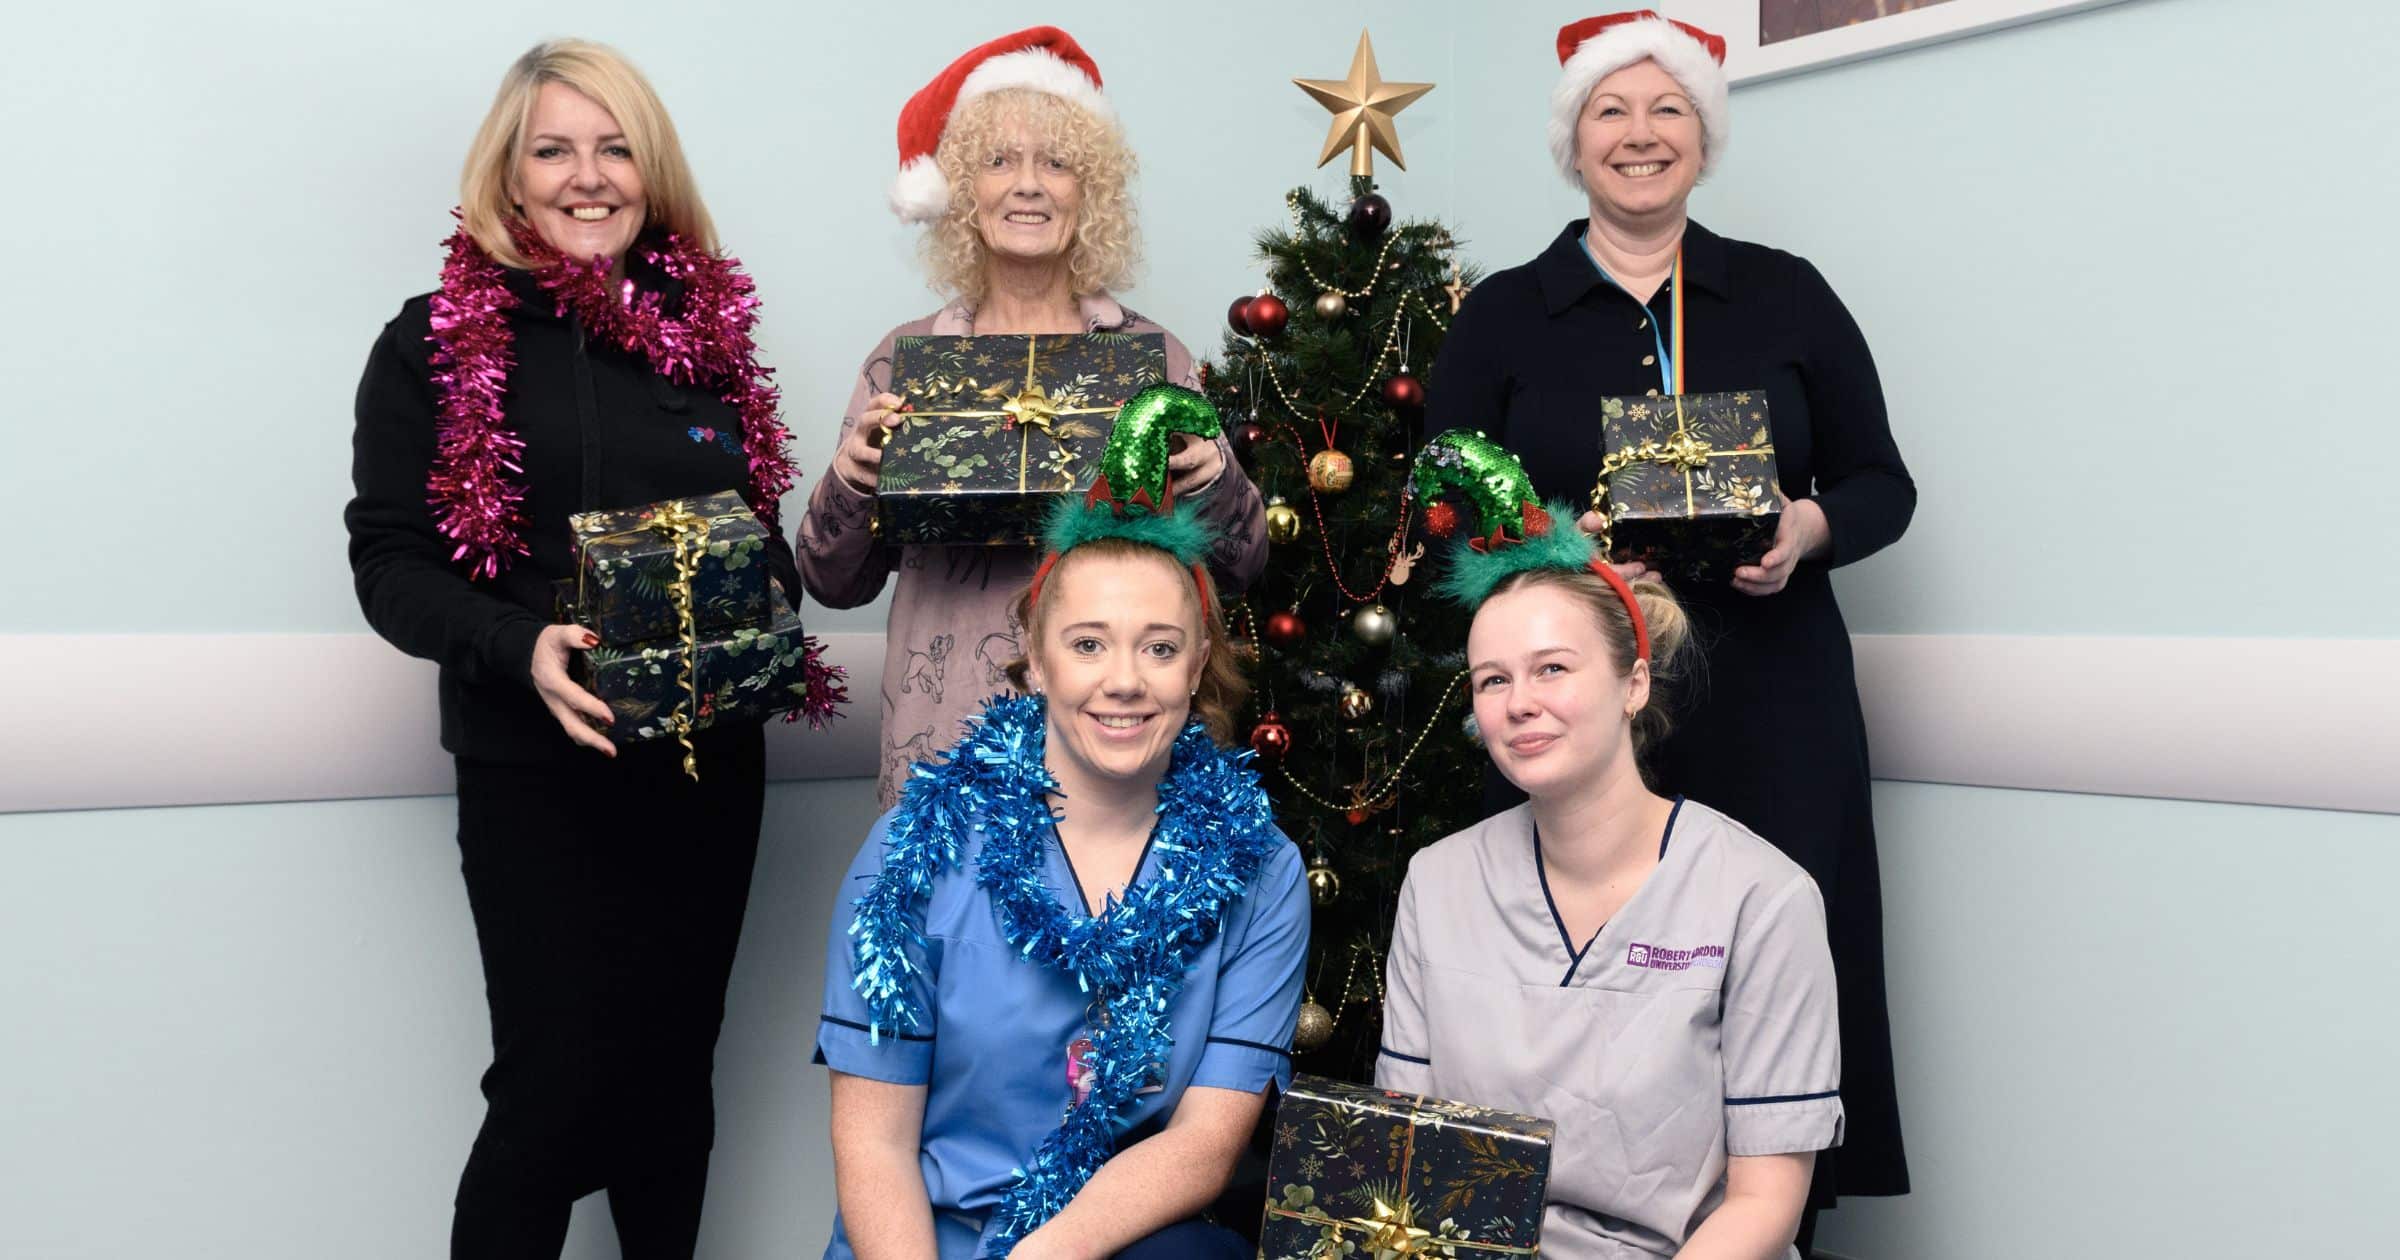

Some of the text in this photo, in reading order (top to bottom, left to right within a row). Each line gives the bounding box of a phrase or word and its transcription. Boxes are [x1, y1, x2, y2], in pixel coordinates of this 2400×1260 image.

[1630, 951, 1648, 964] RGU
[1652, 947, 1692, 961] ROBERT
[1650, 960, 1691, 971] UNIVERSIT
